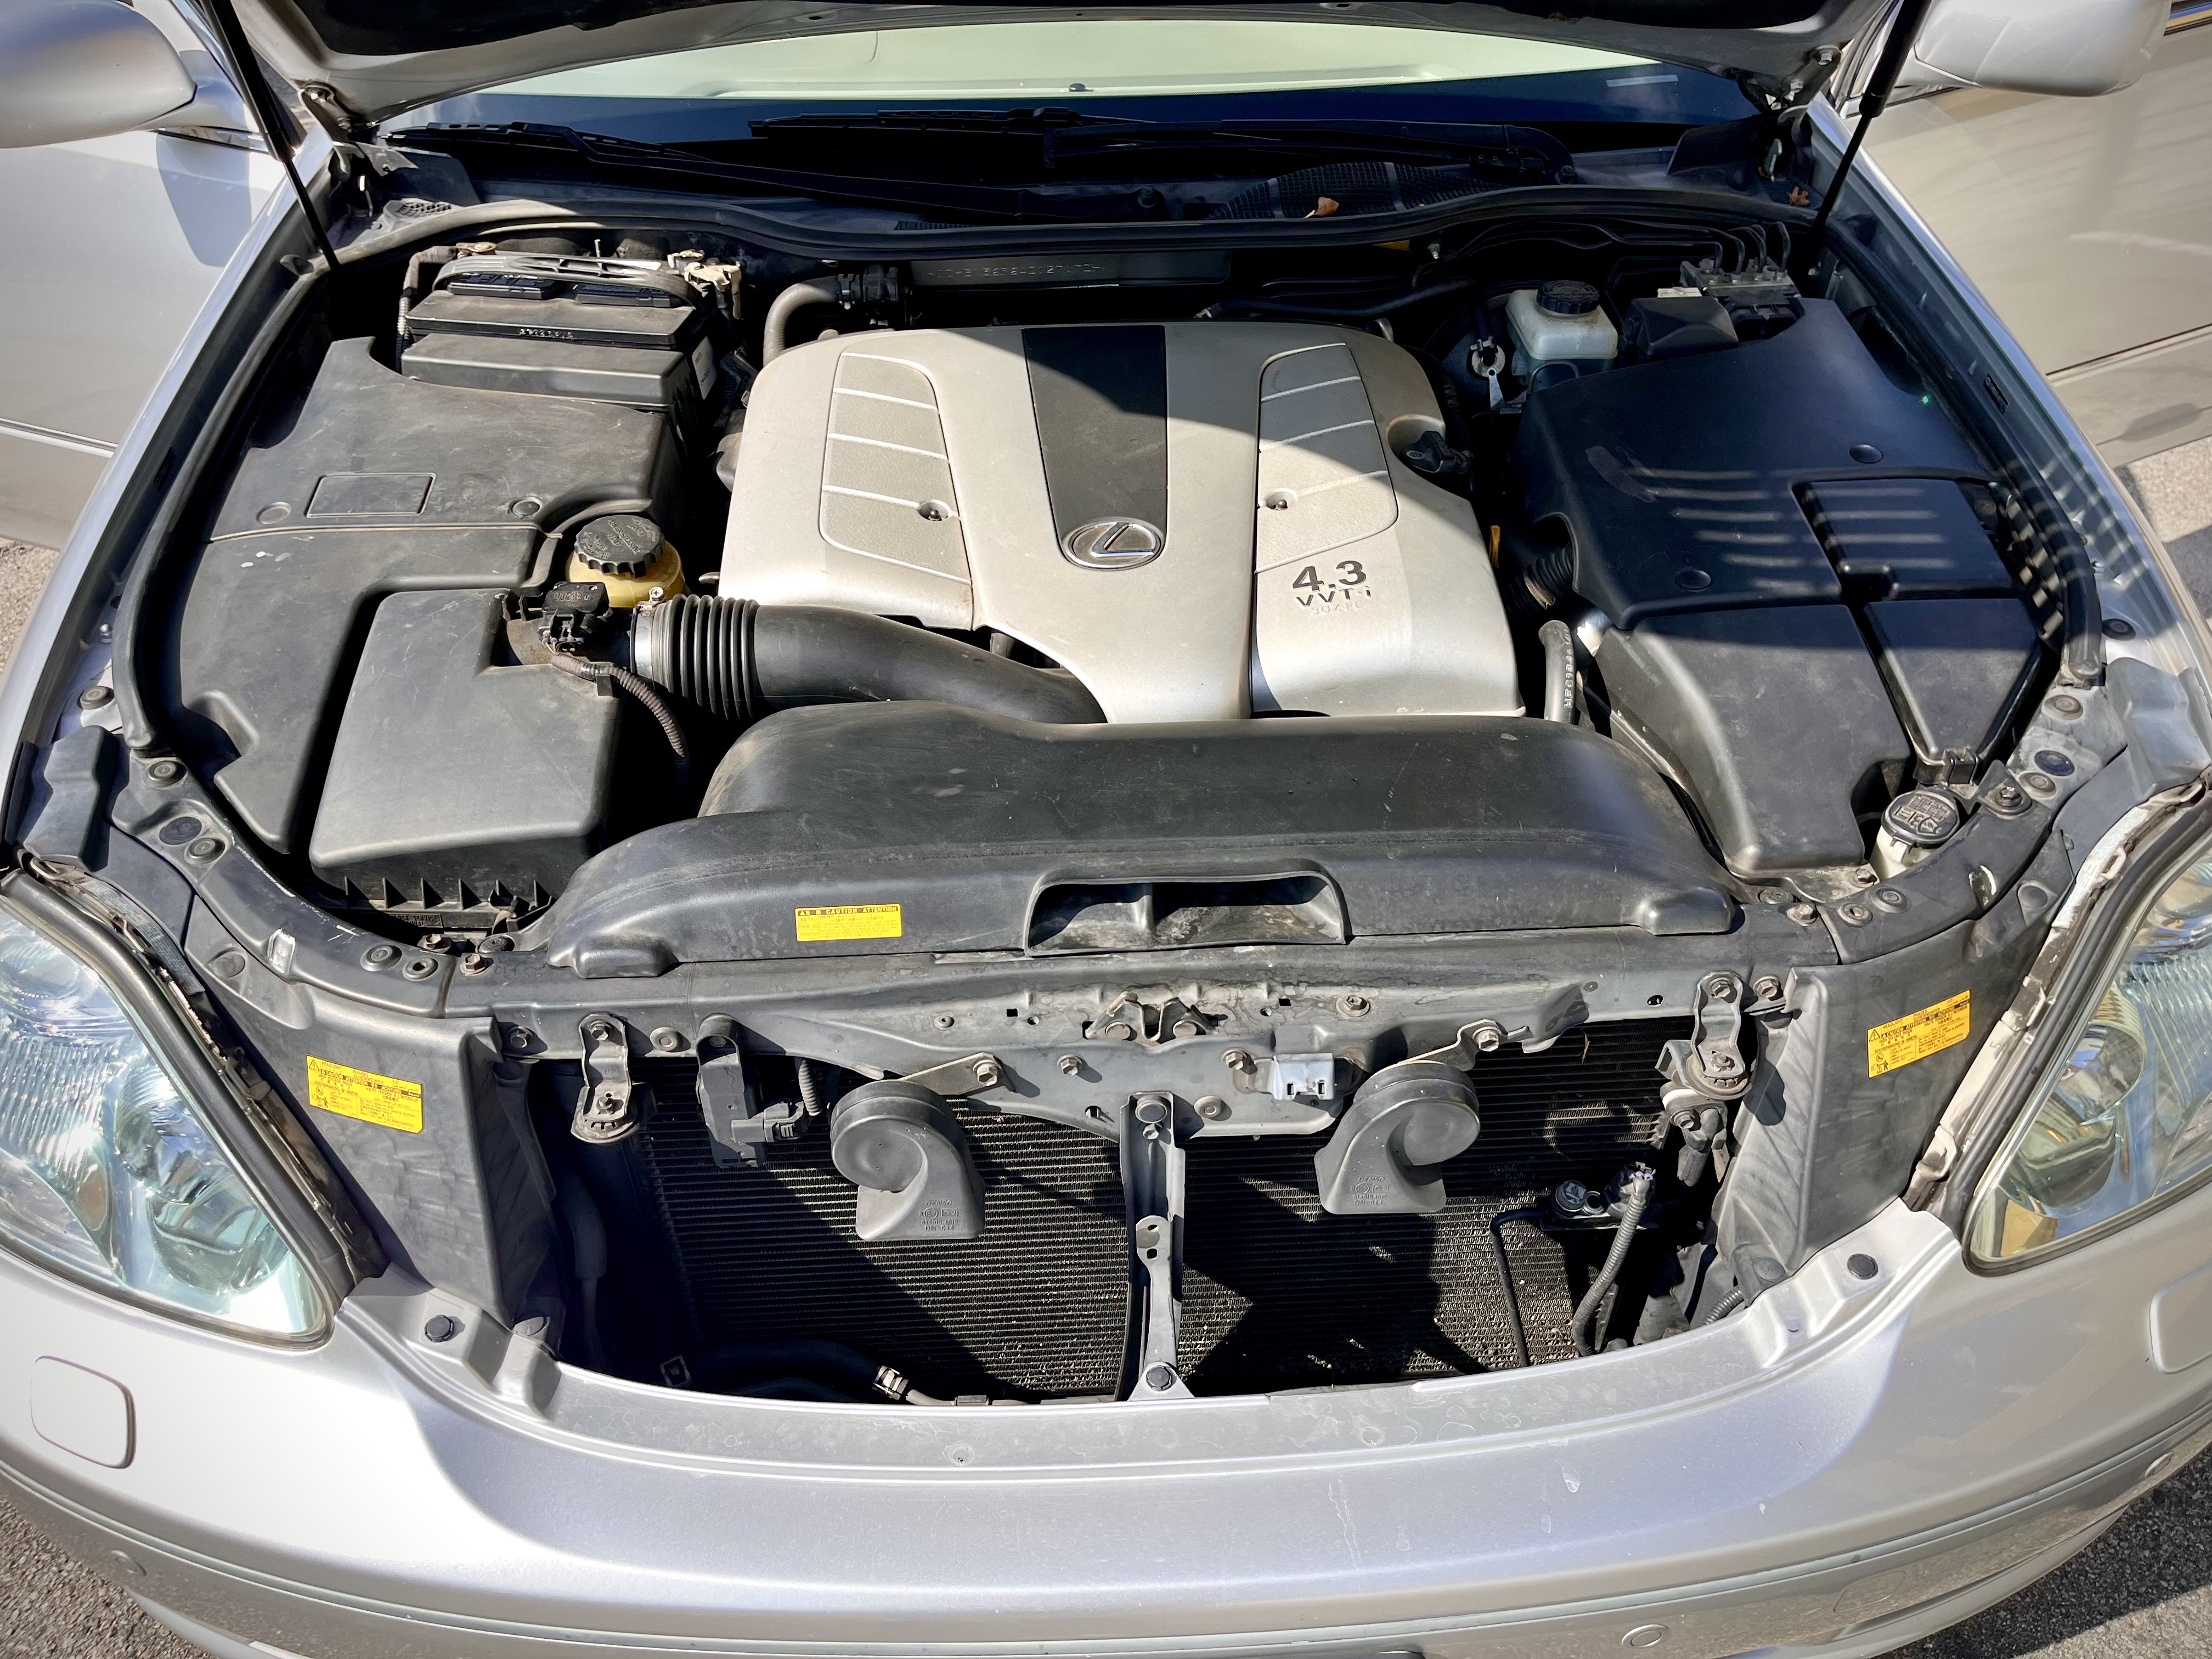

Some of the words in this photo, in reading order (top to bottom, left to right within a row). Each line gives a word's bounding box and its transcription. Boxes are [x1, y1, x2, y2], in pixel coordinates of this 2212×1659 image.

[606, 532, 622, 546] FLUID
[607, 518, 623, 535] POWER
[621, 532, 641, 555] STEERING
[1292, 560, 1367, 592] 4.3
